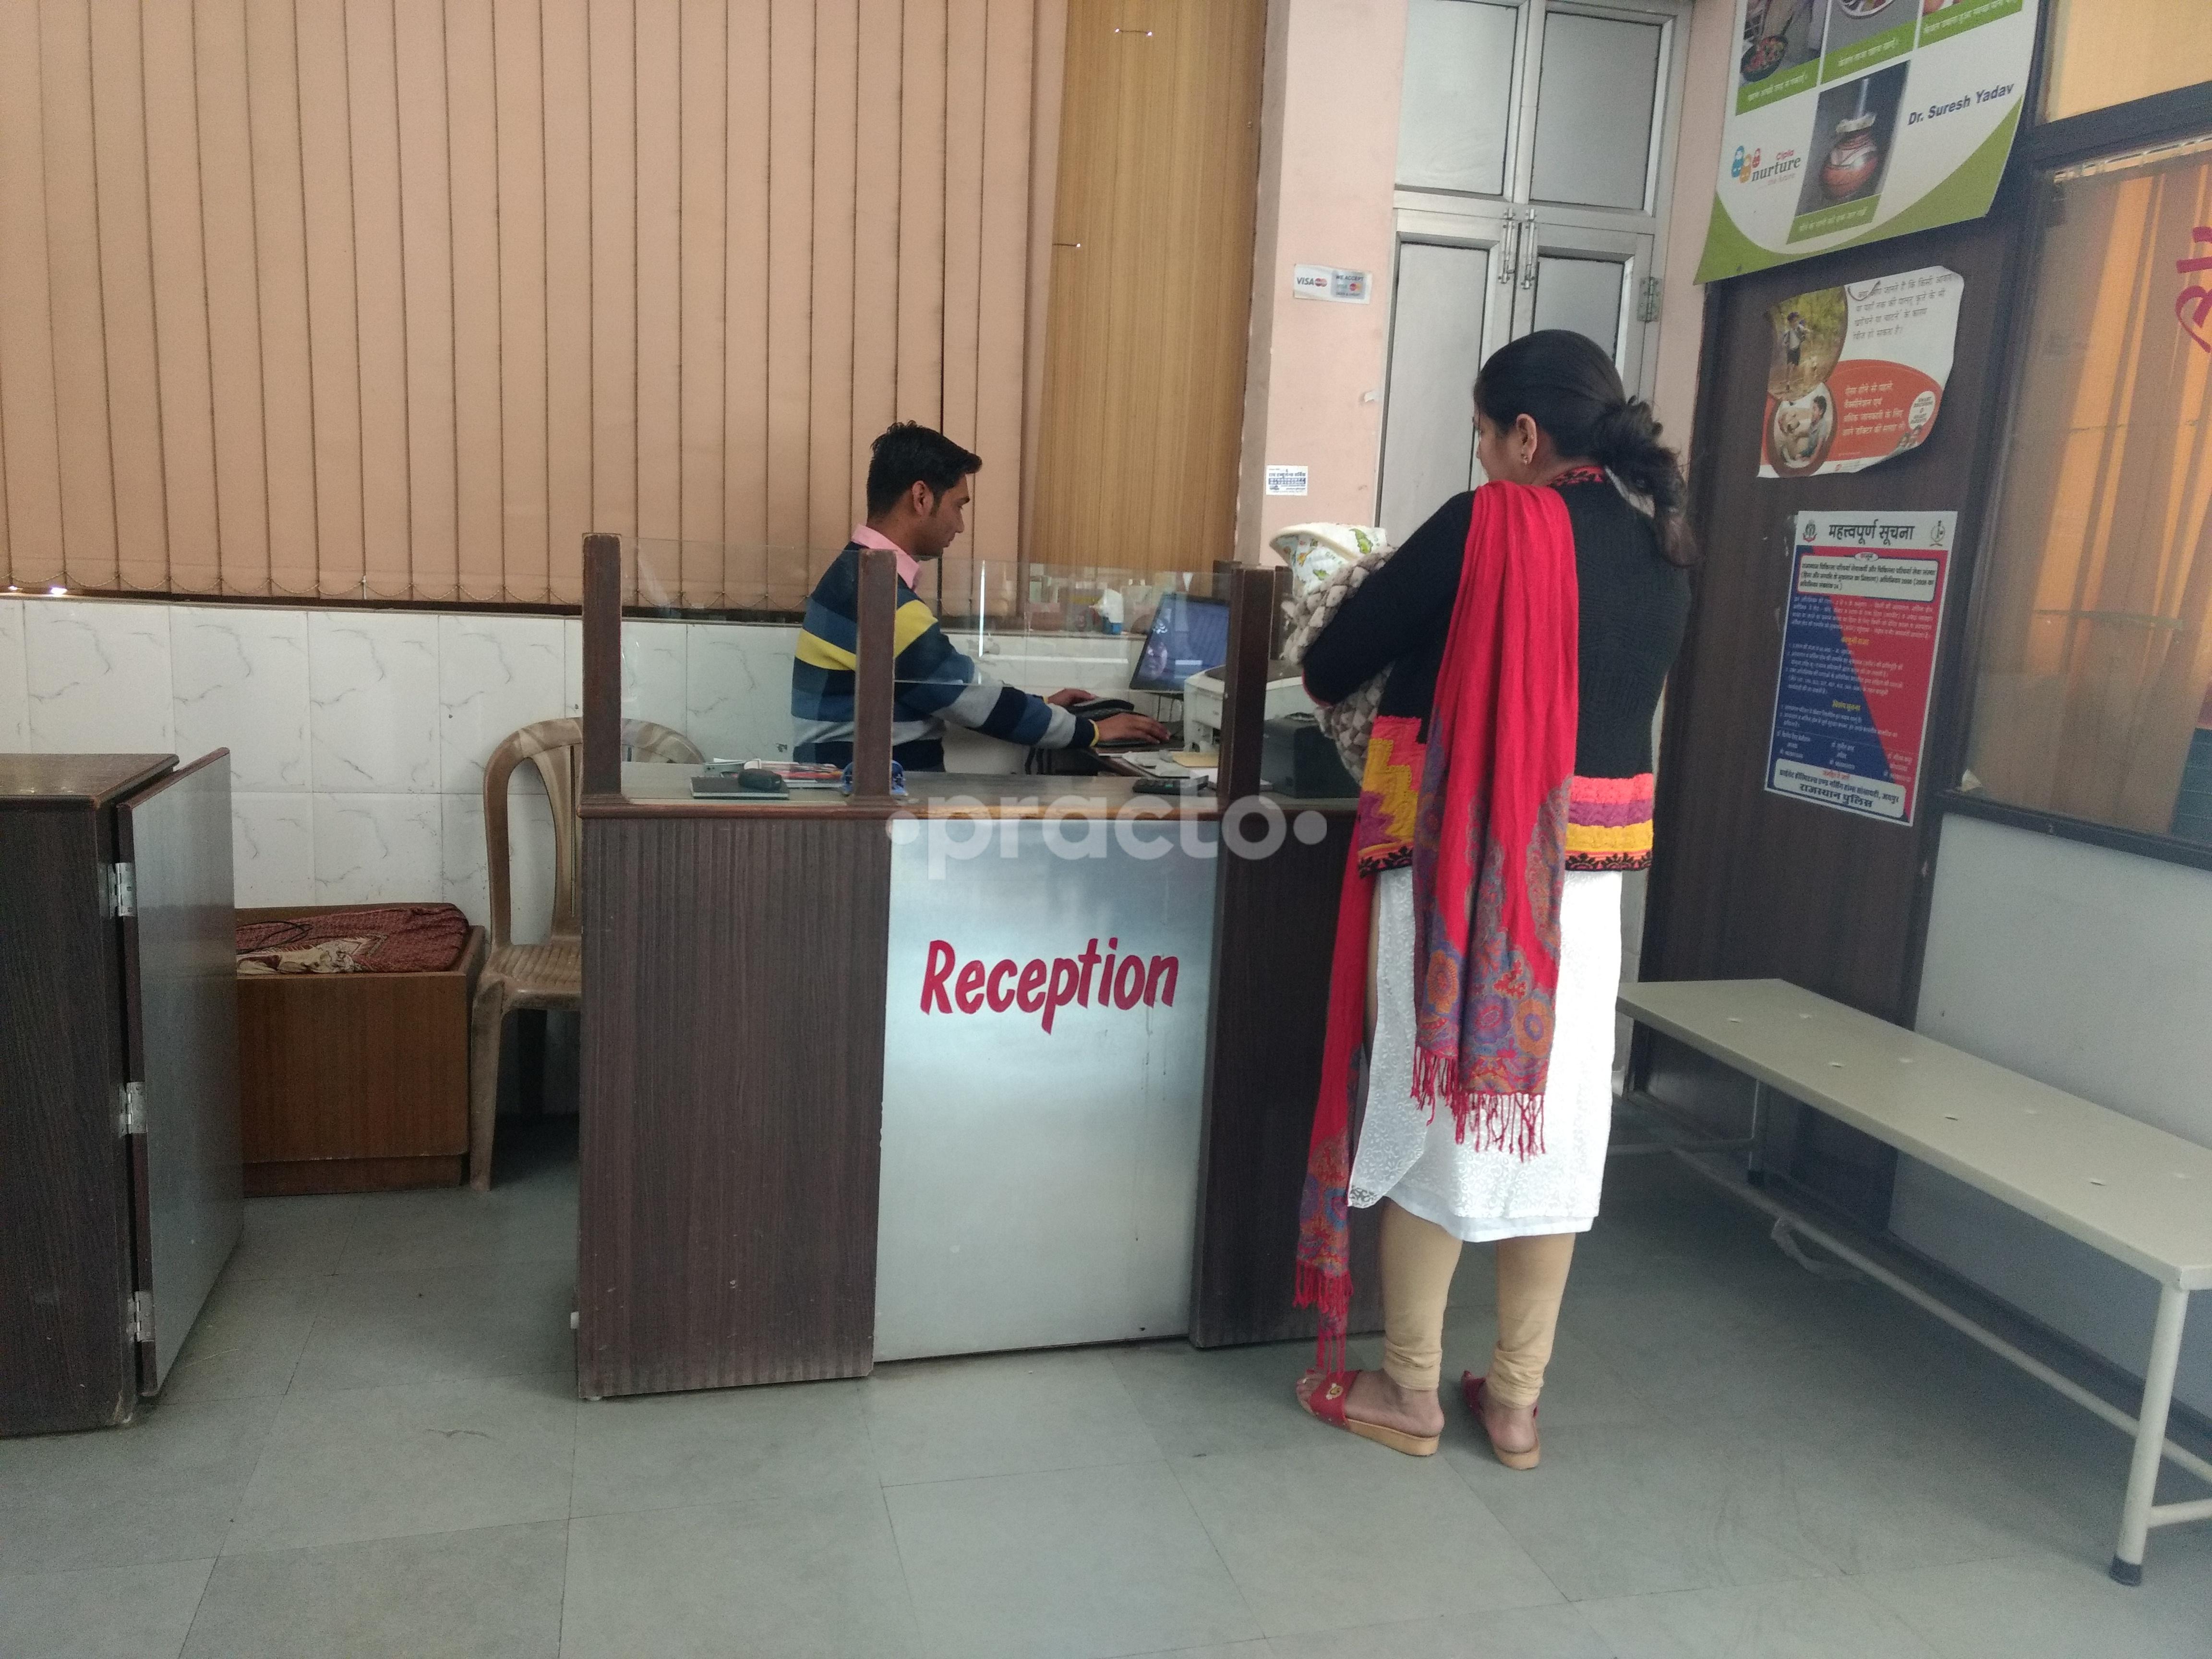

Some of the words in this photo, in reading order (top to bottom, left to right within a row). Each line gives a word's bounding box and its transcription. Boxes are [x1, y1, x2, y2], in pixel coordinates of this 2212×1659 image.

[1907, 111, 1924, 125] Dr.
[1928, 95, 1971, 119] Suresh
[1976, 84, 2014, 104] Yadav
[1751, 157, 1801, 182] nurture
[1297, 277, 1314, 286] VISA
[1828, 519, 1878, 545] महत्त्वपूर्ण
[1879, 525, 1915, 546] सूचना
[1842, 793, 1874, 808] पुलिस
[919, 937, 1179, 1035] Reception
